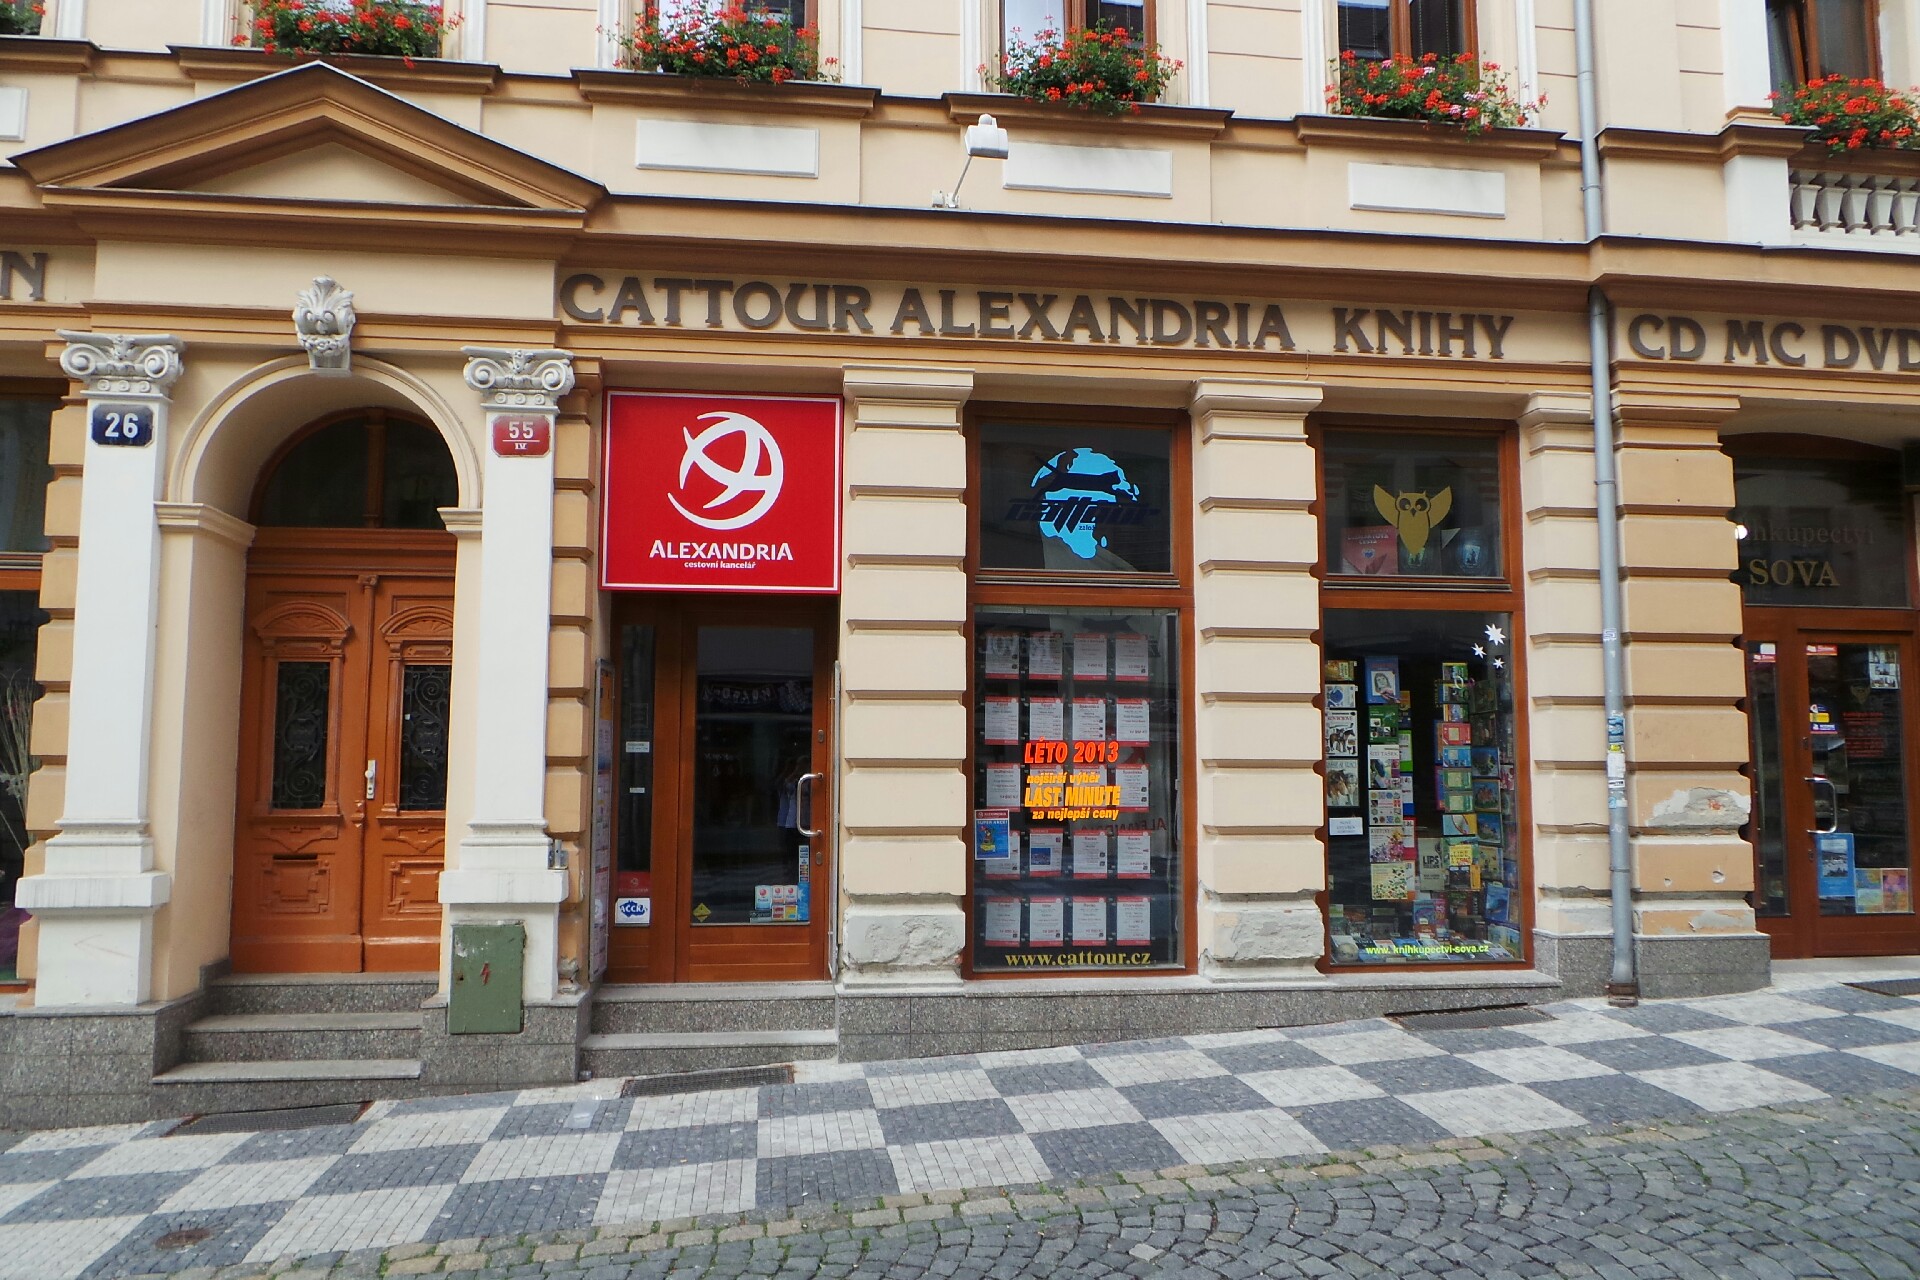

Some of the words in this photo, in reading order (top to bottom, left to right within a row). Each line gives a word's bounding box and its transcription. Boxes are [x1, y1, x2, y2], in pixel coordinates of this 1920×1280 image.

[559, 273, 874, 332] CATTOUR
[890, 288, 1296, 350] ALEXANDRIA
[1332, 307, 1514, 360] KNIHY
[1628, 313, 1706, 361] CD
[1724, 319, 1806, 367] MC
[1821, 324, 1920, 372] DVD
[105, 412, 139, 439] 26
[508, 420, 534, 439] 55
[514, 442, 527, 450] IV
[649, 539, 794, 561] ALEXANDRIA
[684, 560, 718, 568] cestovní
[720, 561, 757, 569] kancelář
[1750, 559, 1841, 587] SOVA
[1024, 736, 1068, 764] LÉTO
[1073, 741, 1119, 763] 2013
[1026, 771, 1066, 785] nejširší
[1069, 772, 1101, 785] výběr
[1024, 786, 1062, 807] LAST
[1064, 785, 1121, 807] MINUTE
[1032, 810, 1045, 820] za
[1047, 808, 1090, 821] nejlepší
[1092, 809, 1119, 821] ceny
[1422, 855, 1440, 864] LIPS
[1005, 950, 1151, 966] www.cattour.cz
